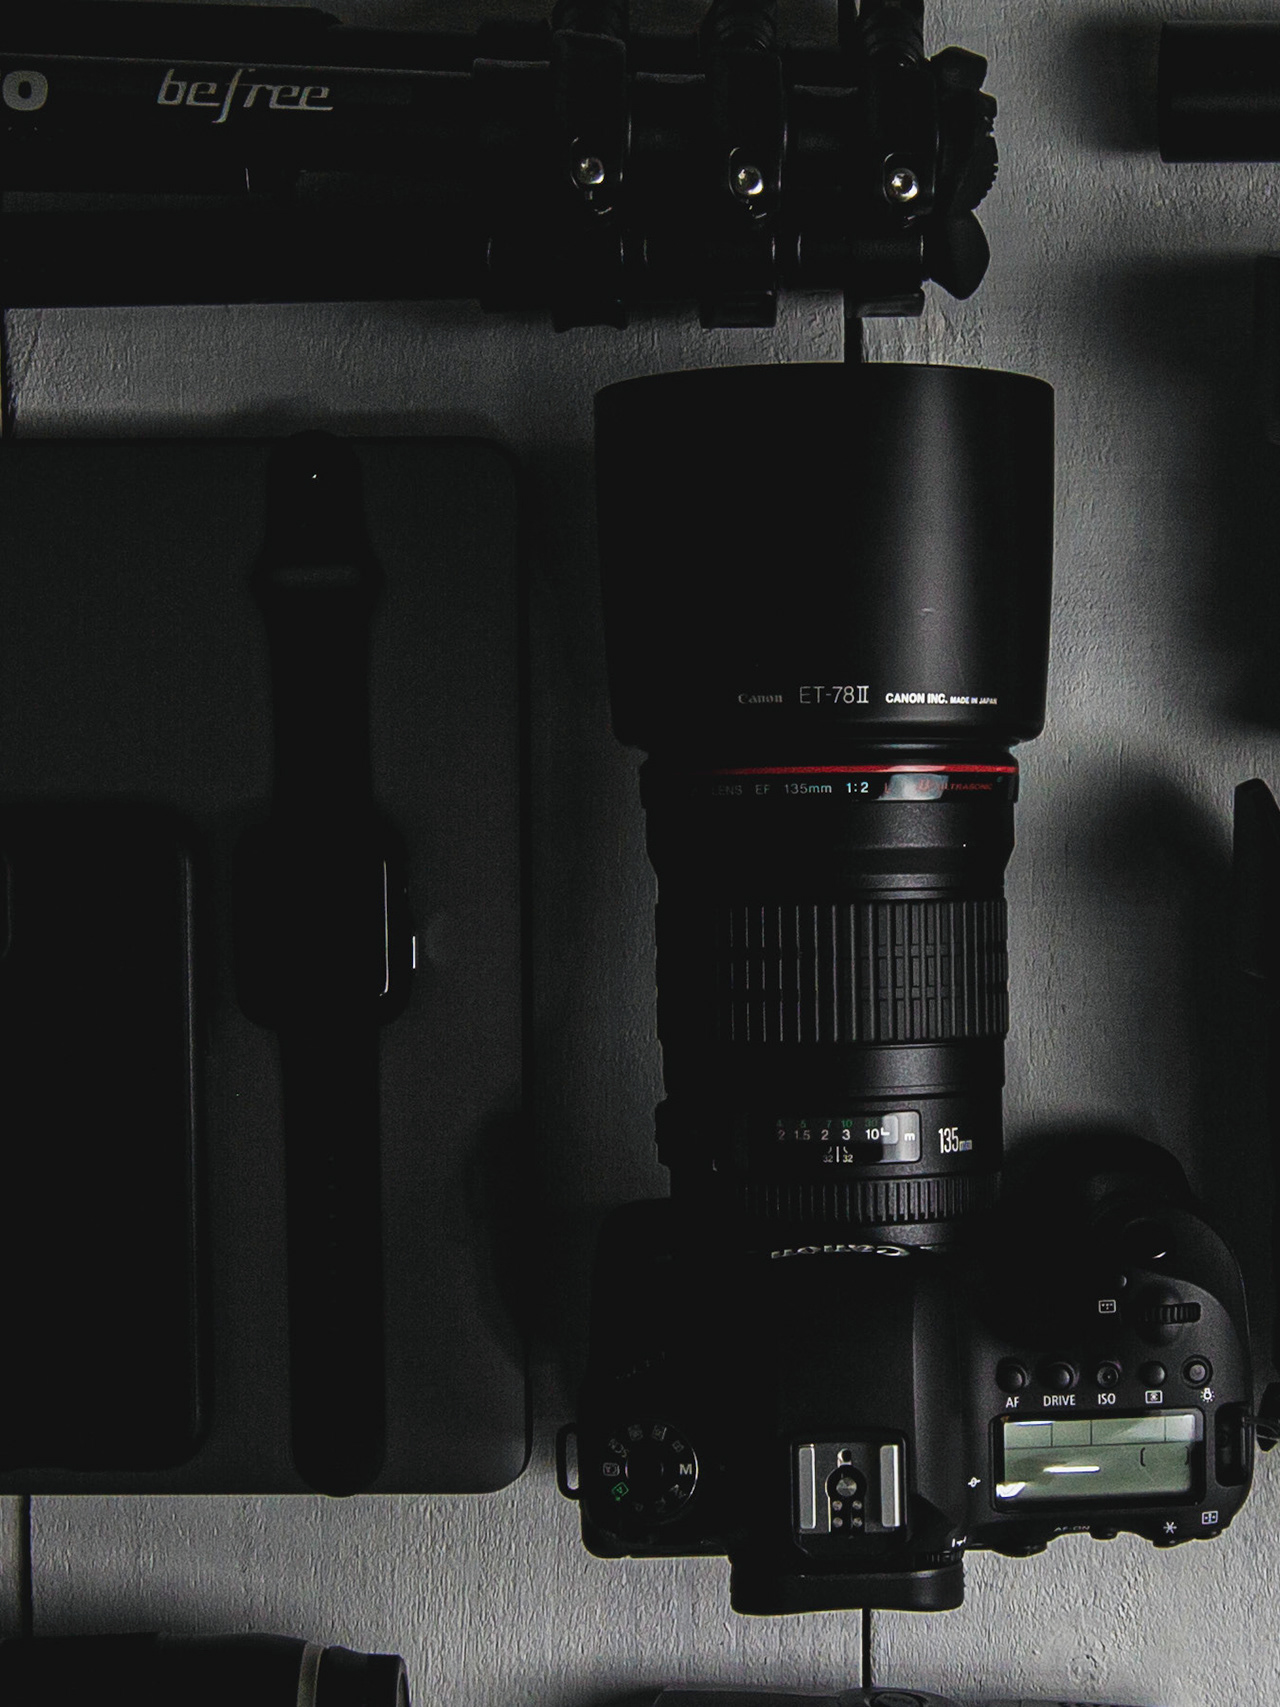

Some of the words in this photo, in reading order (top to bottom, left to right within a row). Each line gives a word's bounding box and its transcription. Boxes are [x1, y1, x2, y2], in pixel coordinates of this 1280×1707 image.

[156, 68, 335, 124] befree
[737, 690, 784, 705] Canon
[885, 692, 926, 704] CANON
[927, 692, 949, 704] INC.
[754, 784, 772, 796] EF
[783, 782, 834, 795] 135mm
[845, 781, 870, 795] 1:2
[841, 1128, 852, 1141] 3
[1006, 1396, 1020, 1409] AF
[1042, 1395, 1076, 1407] DRIVE
[1097, 1393, 1116, 1405] ISO
[679, 1463, 693, 1476] M
